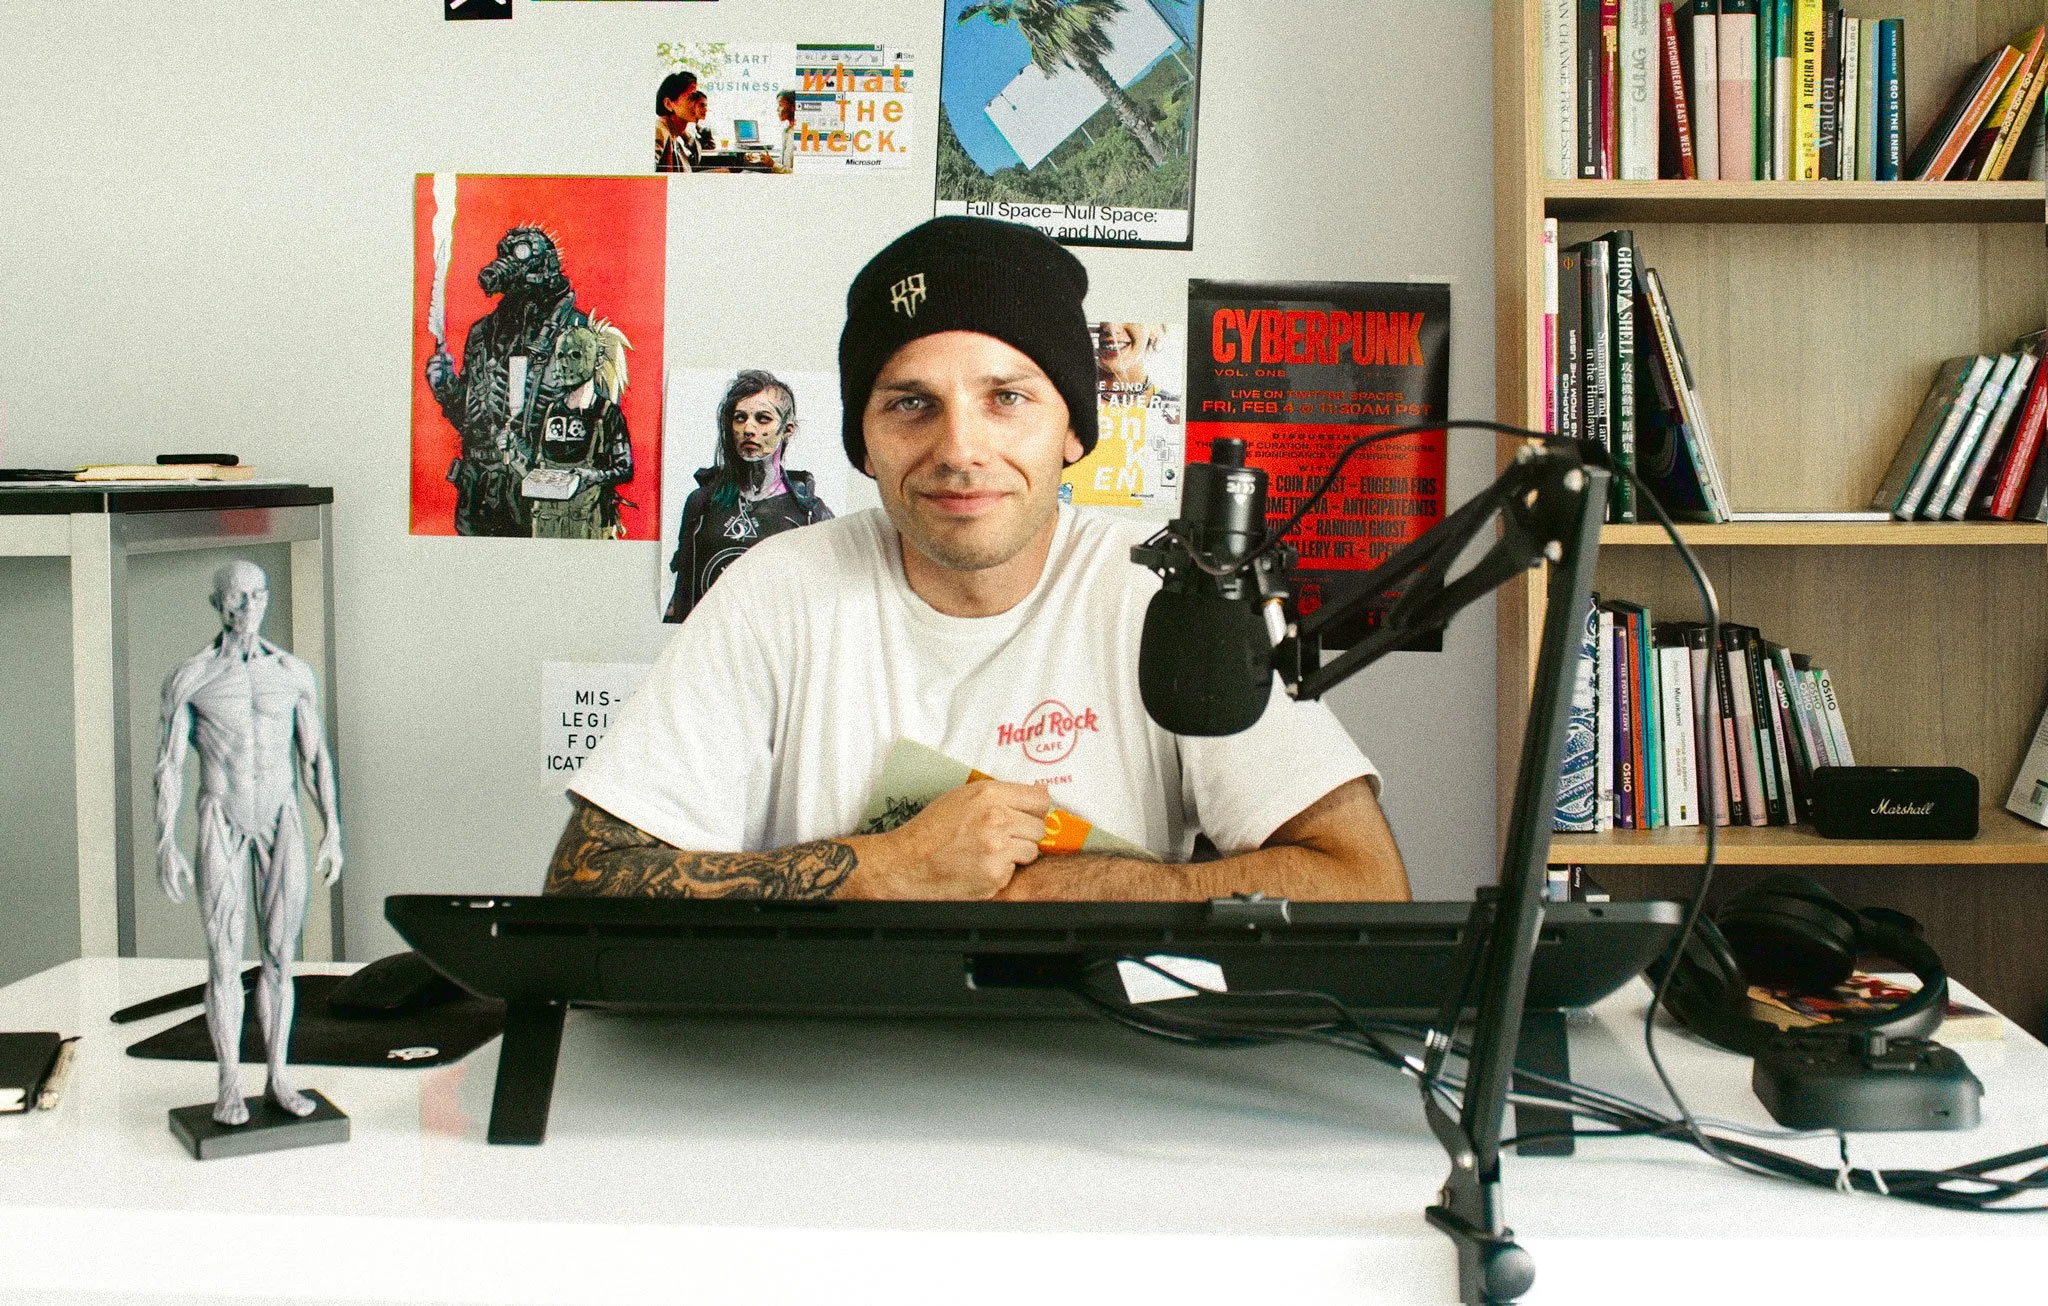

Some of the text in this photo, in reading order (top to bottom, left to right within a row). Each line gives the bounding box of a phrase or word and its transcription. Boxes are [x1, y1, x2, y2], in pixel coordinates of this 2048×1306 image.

[1804, 31, 1815, 53] VAGA
[1559, 24, 1570, 85] CHANGE
[742, 68, 751, 77] A
[1631, 47, 1648, 102] GULAG
[1667, 35, 1684, 100] PSYCHOTHERAPY
[1804, 59, 1815, 95] TERCEIRA
[803, 63, 905, 93] what
[1890, 79, 1898, 98] EGO
[1675, 103, 1688, 119] EAST
[1812, 77, 1836, 150] Walden
[1890, 101, 1898, 110] IS
[1890, 113, 1898, 130] THE
[1560, 91, 1571, 176] PROCESSES
[1680, 136, 1692, 156] WEST
[1890, 133, 1899, 166] ENEMY
[966, 200, 994, 216] Full
[1100, 206, 1158, 224] Space:
[1058, 224, 1090, 239] and
[1094, 225, 1142, 241] None.
[1617, 247, 1633, 296] GHOST
[1211, 308, 1425, 367] CYBERPUNK
[1619, 313, 1634, 358] SHELL
[1587, 348, 1596, 359] in
[1598, 331, 1608, 395] Shamanism
[1214, 368, 1287, 378] VOL. ONE
[1587, 363, 1596, 381] the
[1112, 381, 1143, 392] SIND
[1231, 389, 1405, 401] LIVE ON TWITTER SPACES
[1202, 400, 1433, 417] FRI, FEB 4 @ 11:30AM PST
[1598, 398, 1607, 418] and
[1255, 451, 1326, 459] SIGNIFICANCE
[1276, 475, 1303, 493] COIN
[1360, 476, 1409, 494] EUGENIA
[1317, 519, 1366, 537] RANDOM
[1369, 520, 1406, 537] GHOST
[575, 690, 621, 706] MIS-
[1776, 680, 1790, 709] OSHO
[1800, 682, 1813, 711] OSHO
[1809, 681, 1821, 710] OSHO
[1821, 678, 1836, 711] OSHO
[1674, 687, 1682, 726] Murakami
[562, 712, 607, 728] LEGI
[997, 707, 1100, 747] Hard Rock
[568, 734, 604, 750] FO
[1035, 741, 1063, 753] CAFE
[547, 755, 585, 771] ICAT
[1034, 775, 1073, 785] ATHENS
[1623, 762, 1631, 793] OSHO
[1870, 798, 1935, 816] Marshall
